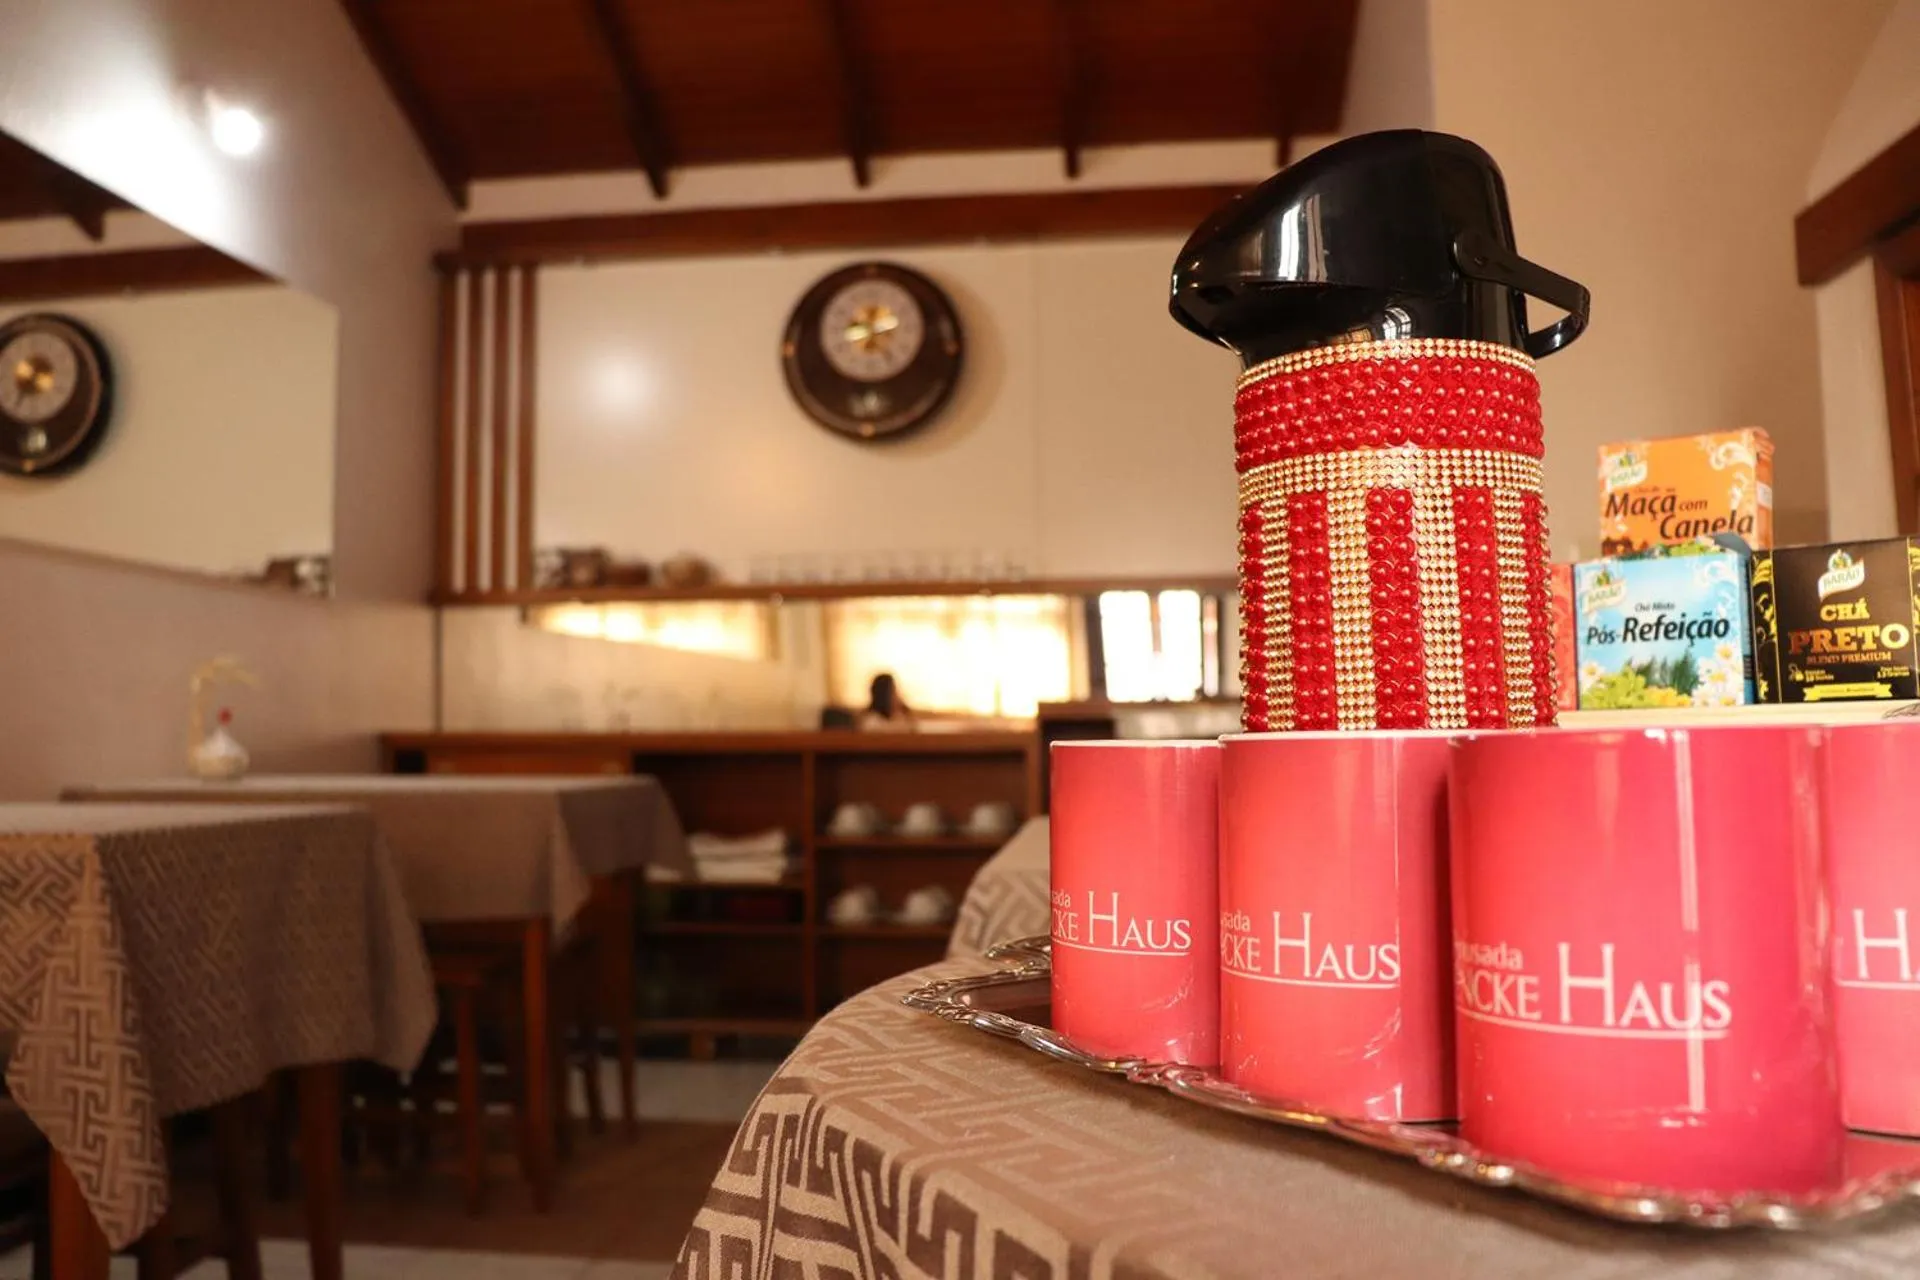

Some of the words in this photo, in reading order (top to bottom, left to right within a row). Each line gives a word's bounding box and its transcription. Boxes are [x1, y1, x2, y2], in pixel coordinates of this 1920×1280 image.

[1679, 500, 1708, 512] com
[1660, 510, 1754, 539] Canela
[1820, 597, 1870, 622] CHÁ
[1788, 623, 1909, 654] PRETO
[1842, 651, 1891, 663] PREMIUM
[1088, 891, 1192, 950] HAUS
[1273, 911, 1401, 981] HAUS
[1557, 943, 1732, 1029] HAUS
